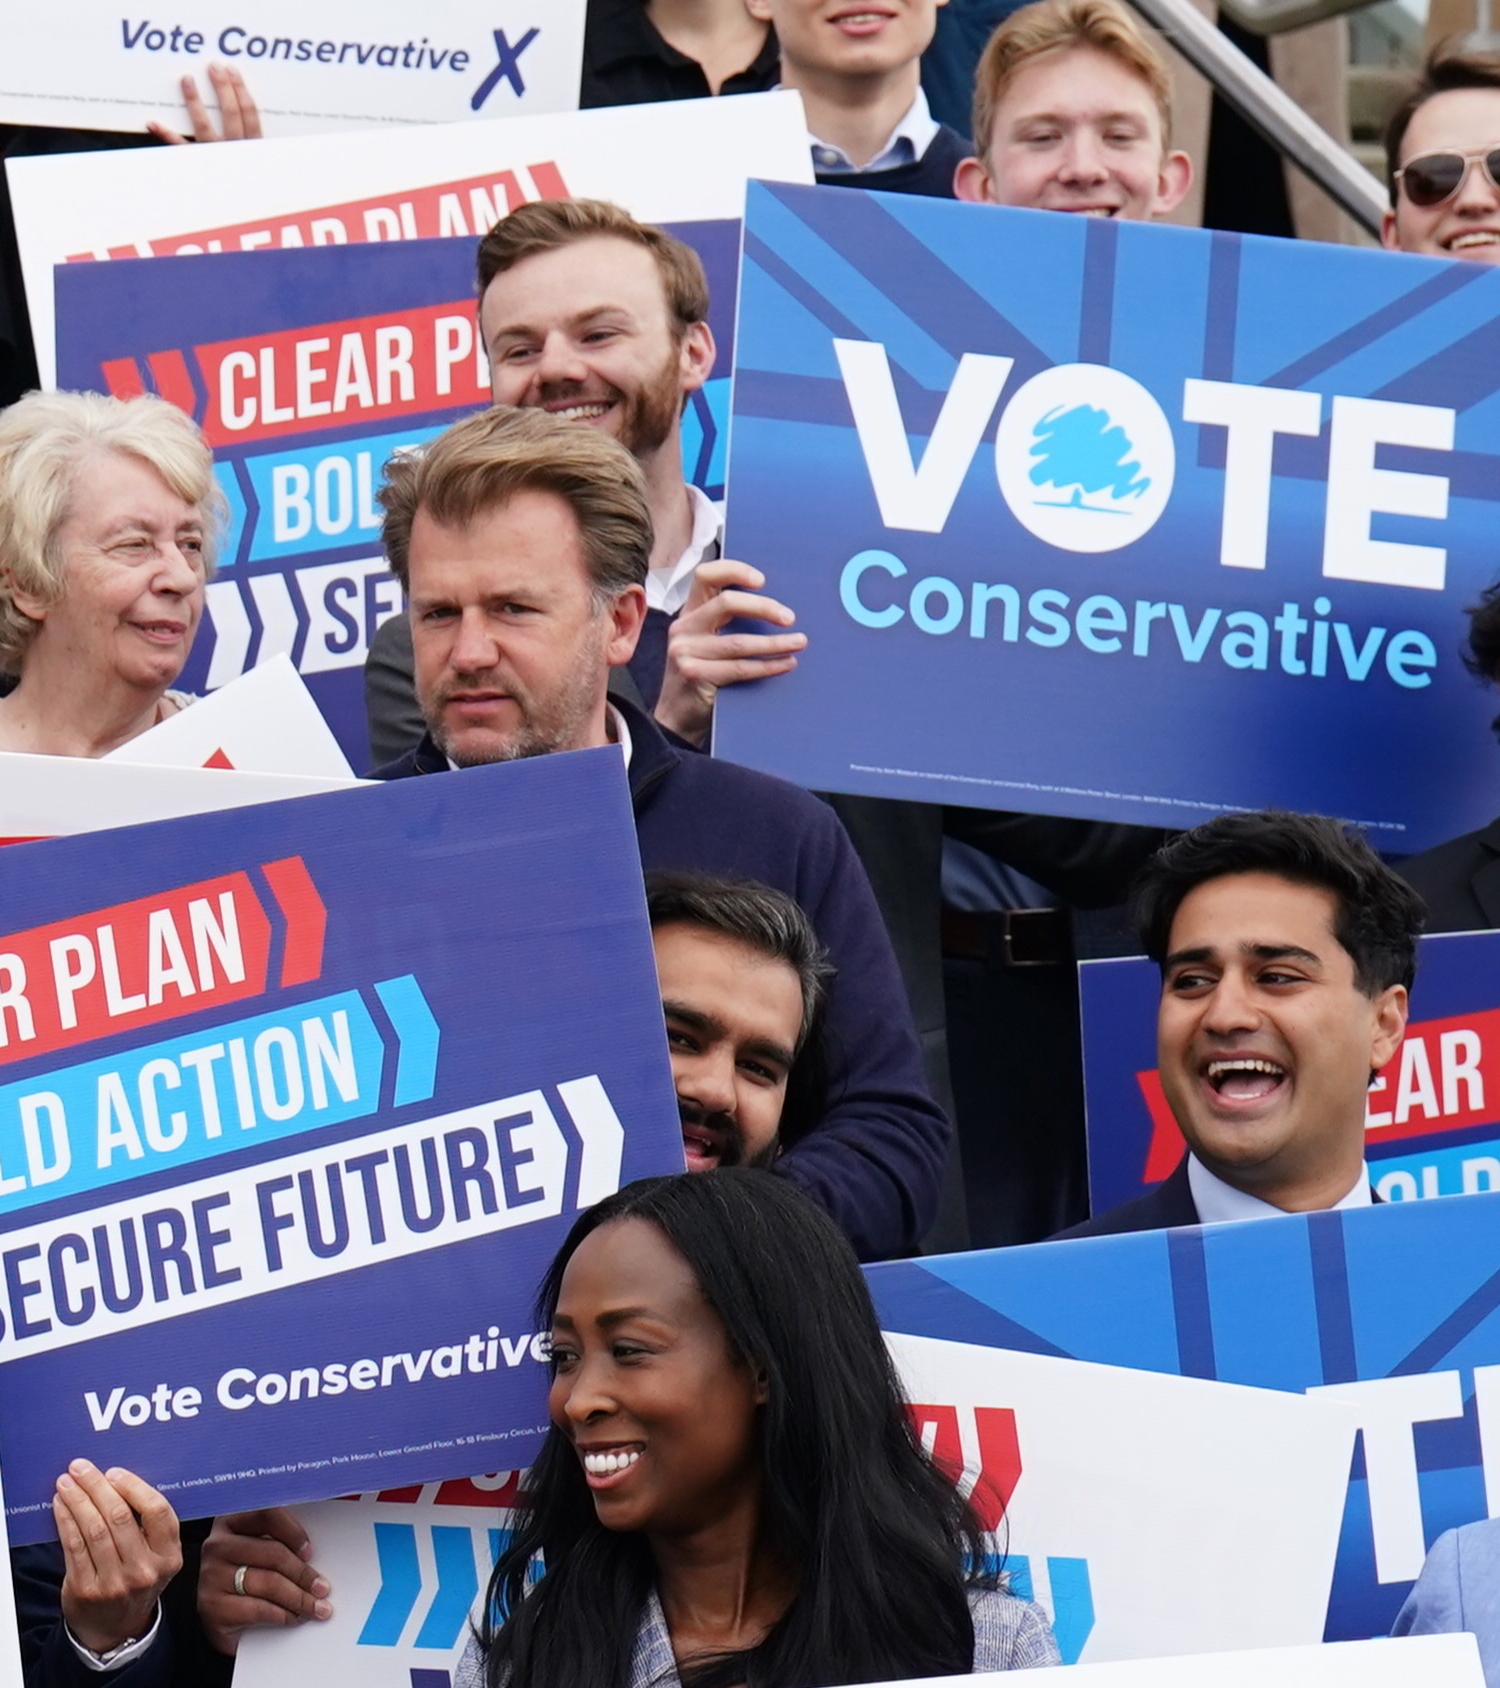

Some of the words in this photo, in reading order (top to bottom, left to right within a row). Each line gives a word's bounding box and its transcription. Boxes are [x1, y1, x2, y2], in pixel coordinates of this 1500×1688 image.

[120, 19, 205, 54] Vote
[218, 26, 471, 73] Conservative
[219, 326, 415, 431] CLEAR
[273, 450, 390, 543] BOL
[833, 338, 1456, 591] VOTE
[839, 549, 1437, 690] Conservative
[49, 891, 247, 1030] PLAN
[97, 1010, 360, 1170] ACTION
[262, 1111, 544, 1274] FUTURE
[84, 1382, 203, 1431] Vote
[218, 1322, 555, 1411] Conservative
